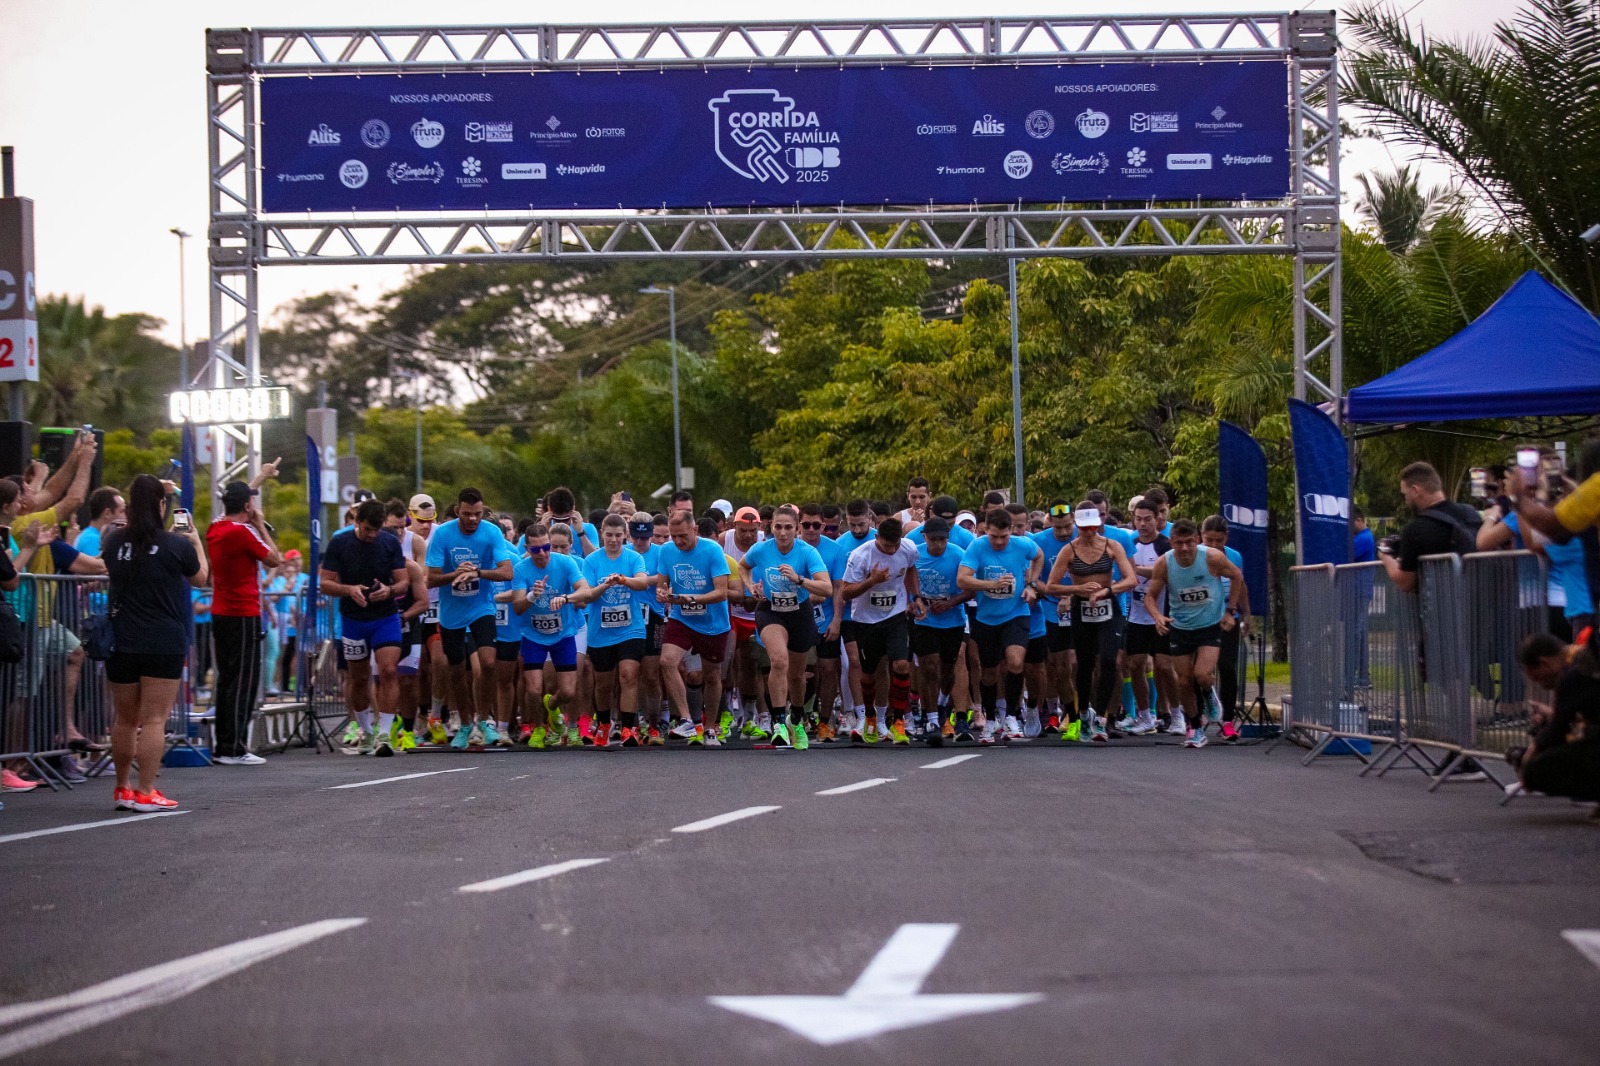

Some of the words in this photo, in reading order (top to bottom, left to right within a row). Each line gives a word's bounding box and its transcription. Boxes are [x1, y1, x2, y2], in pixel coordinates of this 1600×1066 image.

[1055, 85, 1094, 93] NOSSOS
[1096, 84, 1159, 92] APOIADORES:
[390, 94, 429, 103] NOSSOS
[431, 93, 493, 102] APOIADORES:
[728, 111, 820, 127] CORRIDA
[1078, 116, 1106, 127] fruta
[415, 127, 442, 136] fruta
[784, 128, 840, 143] FAMÍLIA
[1060, 153, 1101, 169] Simples
[1234, 154, 1272, 166] Hapvida
[395, 162, 435, 178] Simples
[568, 164, 605, 175] Hapvida
[946, 166, 985, 174] humana
[286, 173, 324, 182] humana
[796, 170, 829, 182] 2025
[774, 597, 795, 607] 525
[876, 596, 893, 606] 511
[1184, 591, 1207, 602] 479
[1084, 606, 1106, 617] 480
[604, 613, 625, 622] 506
[535, 620, 556, 630] 203
